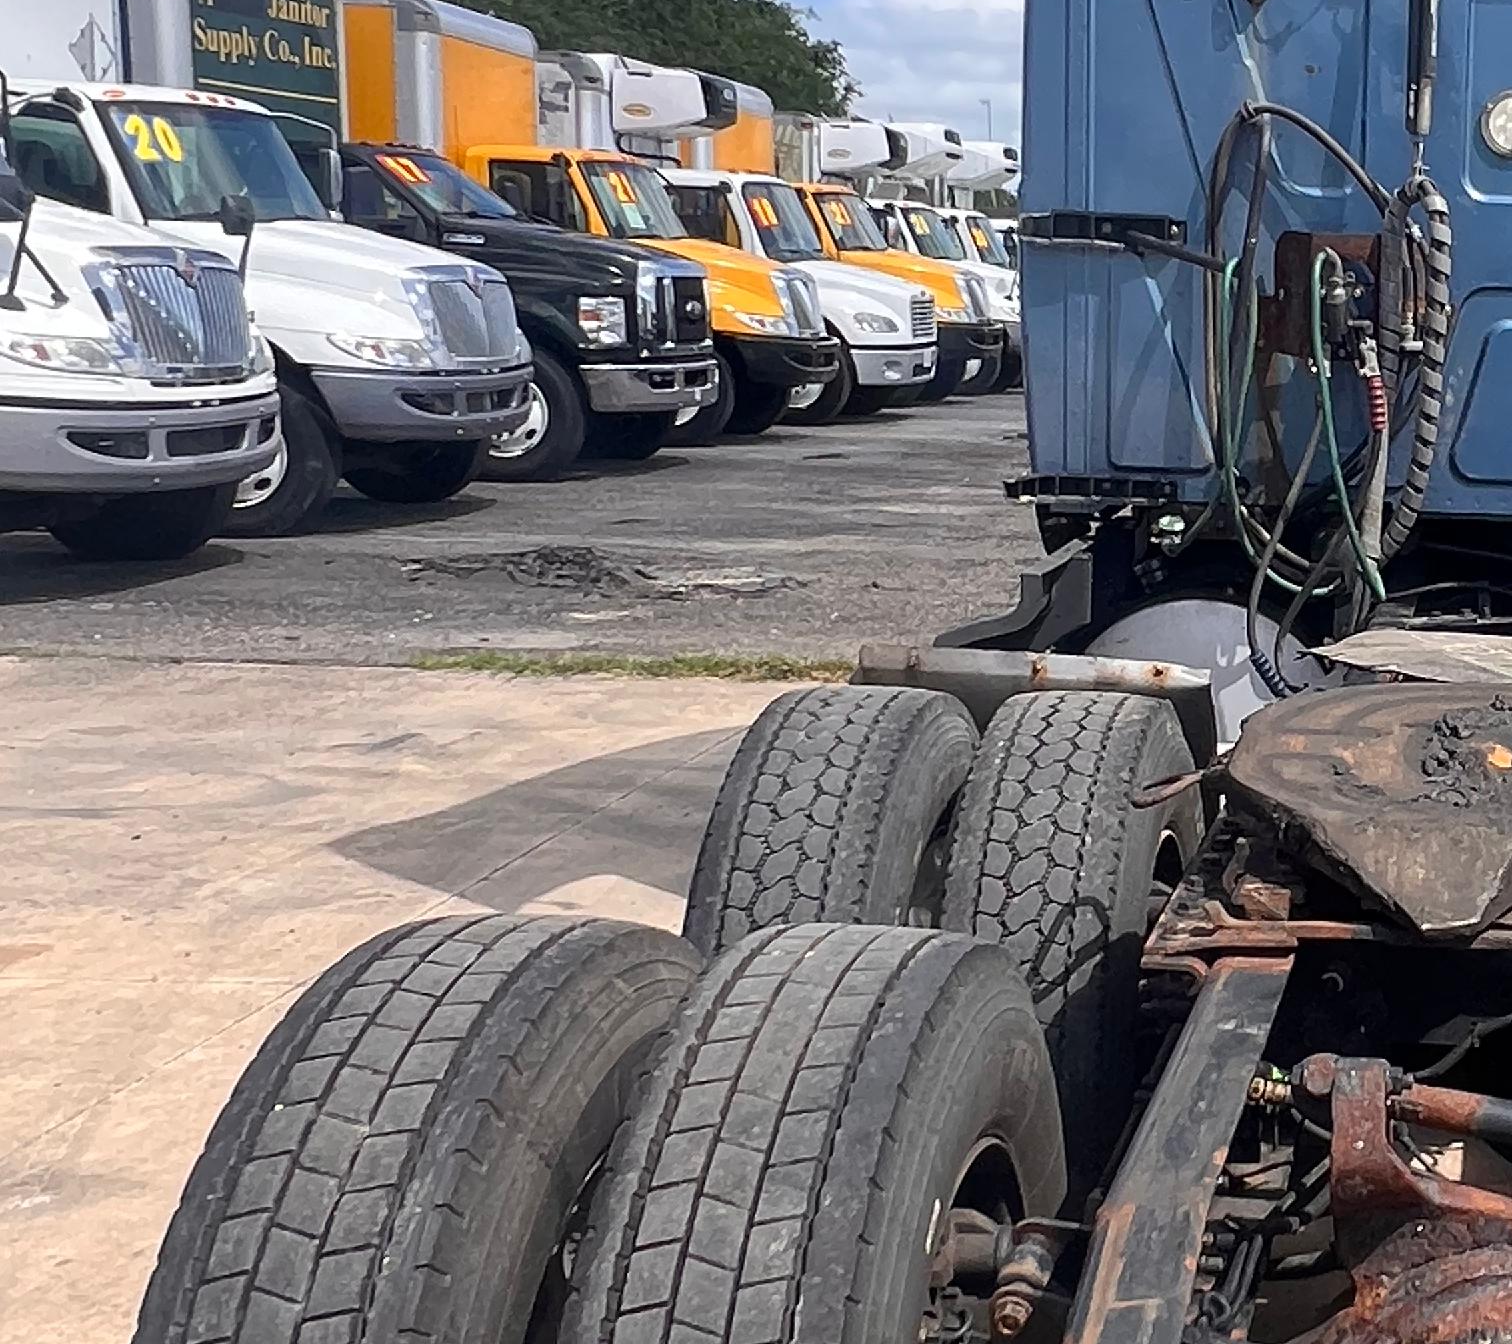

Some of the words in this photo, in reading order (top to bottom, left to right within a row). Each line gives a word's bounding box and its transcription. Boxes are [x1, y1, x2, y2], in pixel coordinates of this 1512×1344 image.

[193, 17, 259, 66] Supply
[304, 36, 336, 70] Inc.
[124, 114, 182, 162] 20
